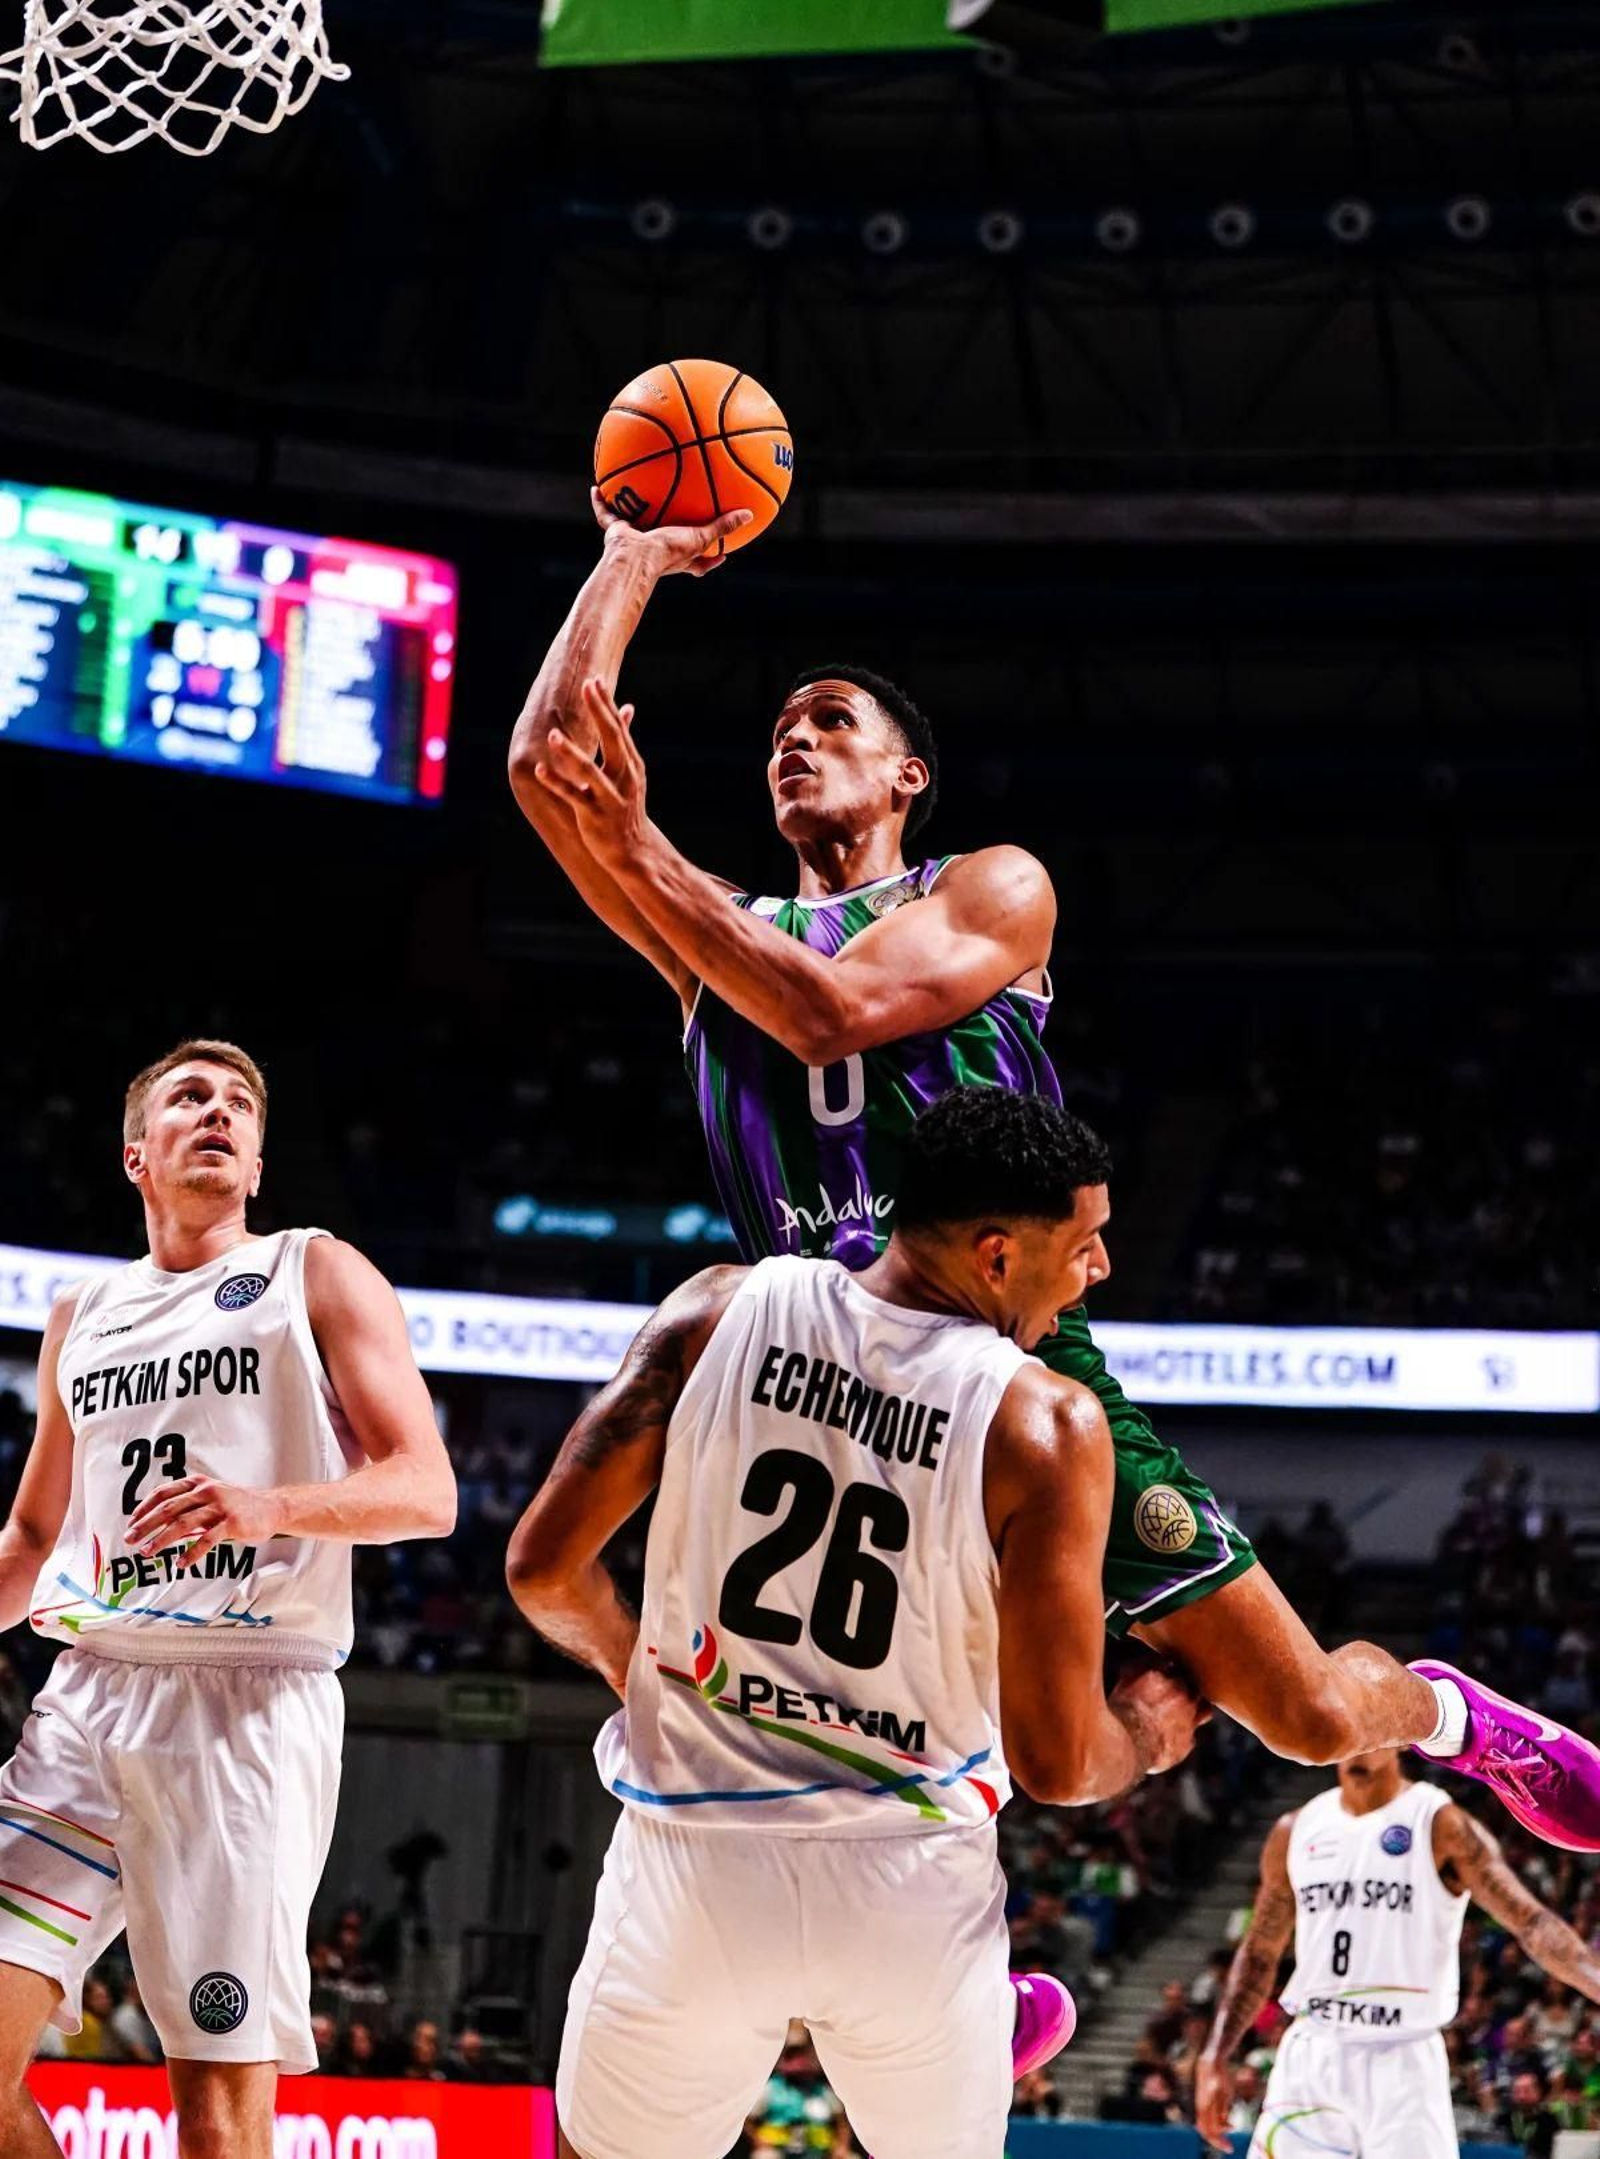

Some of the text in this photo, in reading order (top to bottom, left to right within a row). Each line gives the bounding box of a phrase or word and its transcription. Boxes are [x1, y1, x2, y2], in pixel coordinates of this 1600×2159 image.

[776, 1173, 895, 1246] Andaluc
[176, 1346, 260, 1398] SPOR
[453, 1318, 636, 1359] BOUTIQU
[750, 1345, 950, 1471] ECHENIQUE
[121, 1432, 187, 1516] 23
[718, 1448, 910, 1670] 26
[1332, 1930, 1351, 1976] 8
